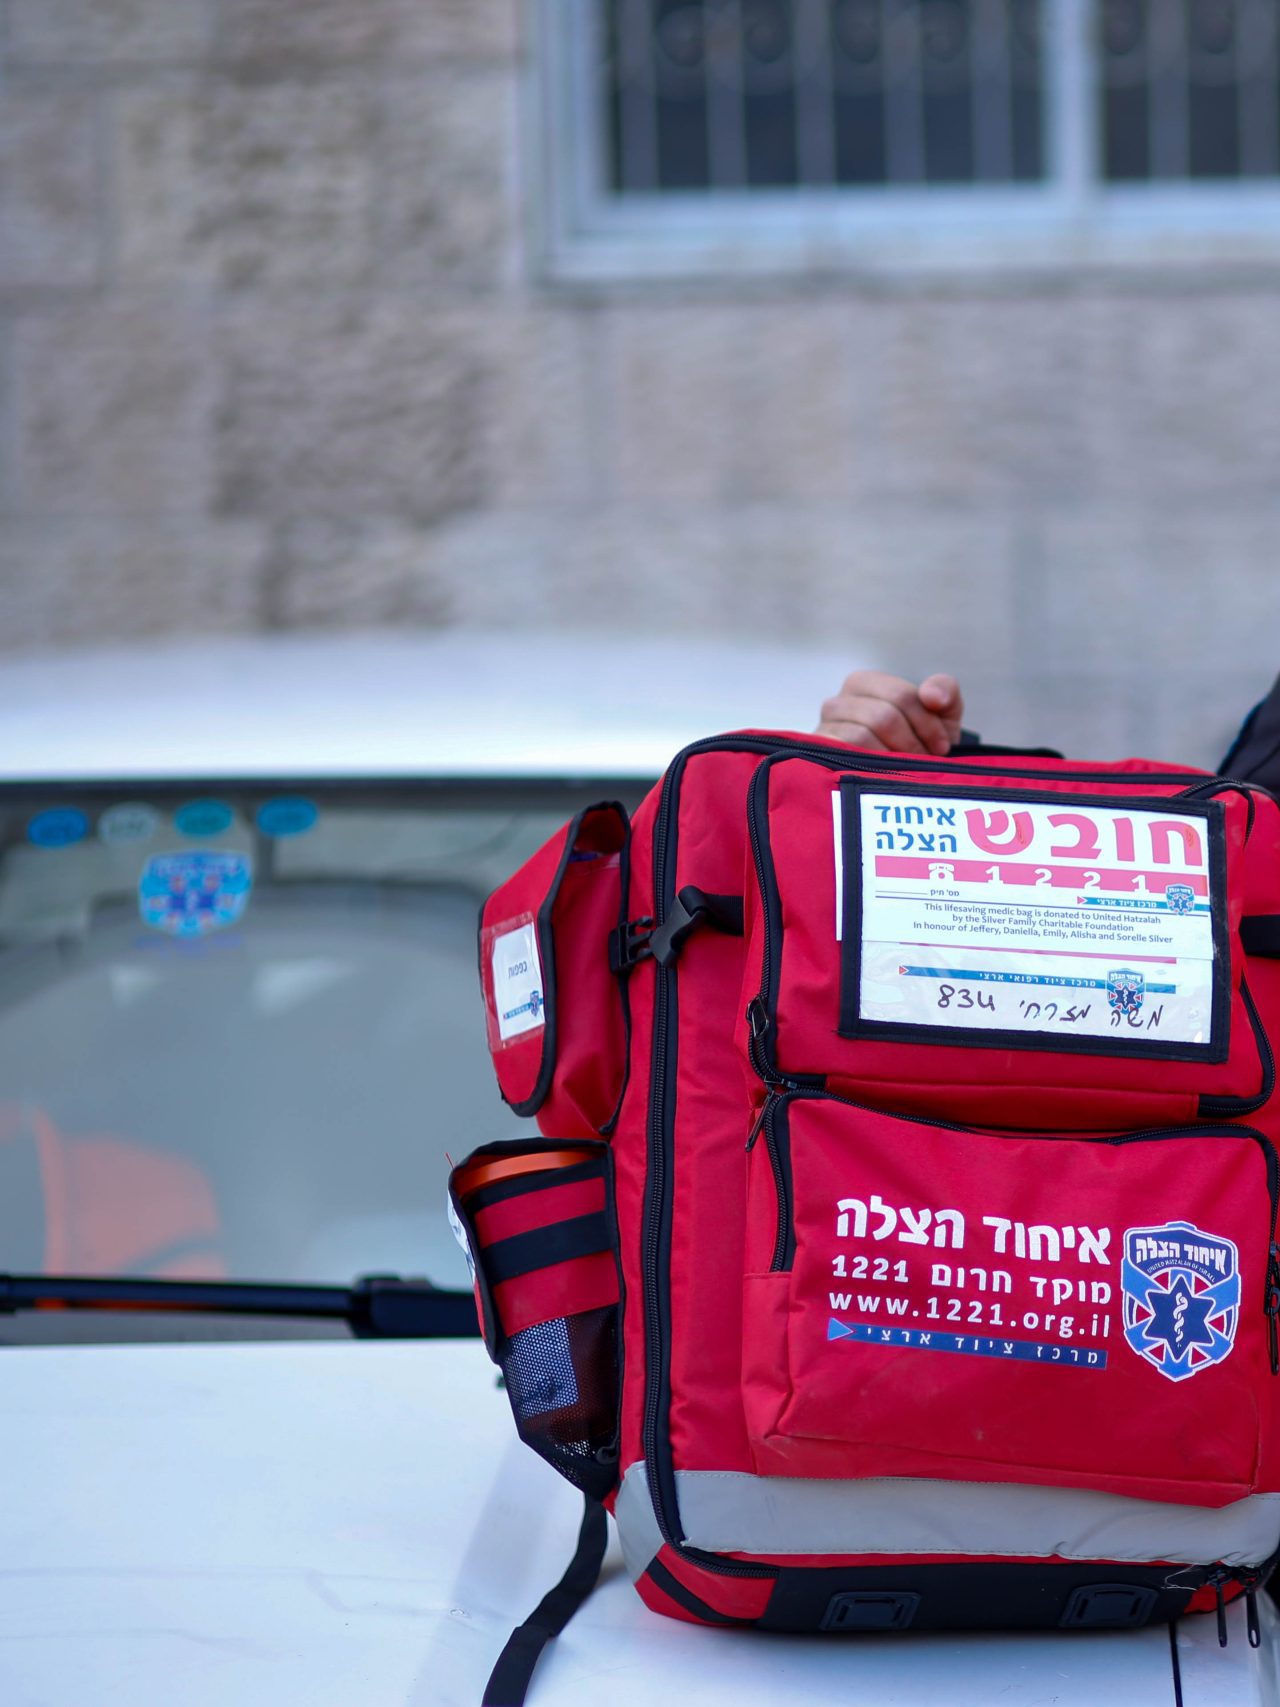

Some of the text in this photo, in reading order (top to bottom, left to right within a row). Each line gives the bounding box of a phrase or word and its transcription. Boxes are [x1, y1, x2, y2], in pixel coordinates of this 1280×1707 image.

[874, 805, 956, 827] איחוד
[875, 828, 958, 853] הצלה
[963, 808, 1204, 867] חובש
[925, 903, 943, 911] This
[944, 903, 986, 915] lifesaving
[988, 907, 1014, 916] medic
[1016, 908, 1032, 918] bag
[1043, 910, 1079, 920] donated
[1093, 913, 1121, 922] United
[1124, 915, 1161, 924] Hatzalah
[952, 914, 1134, 932] by the Silver Family Charitable Foundation
[913, 921, 922, 929] In
[924, 922, 955, 931] honour
[957, 924, 967, 932] of
[969, 925, 1001, 935] Jeffery,
[1003, 927, 1040, 937] Daniella,
[1043, 929, 1068, 939] Emily,
[1070, 931, 1097, 939] Alisha
[1117, 934, 1147, 942] Sorelle
[1149, 935, 1173, 943] Silver
[979, 972, 1096, 987] מרכז ציוד רפואי ארצי
[937, 984, 996, 1011] 834
[1110, 1004, 1164, 1030] משה
[836, 1194, 1111, 1265] איחוד הצלה
[1135, 1237, 1227, 1276] איחוד הצלה
[832, 1254, 1112, 1306] מוקד חרום 1221
[828, 1291, 1111, 1339] www.1221.org.il
[867, 1327, 1098, 1364] מרכז ציוד ארצי
